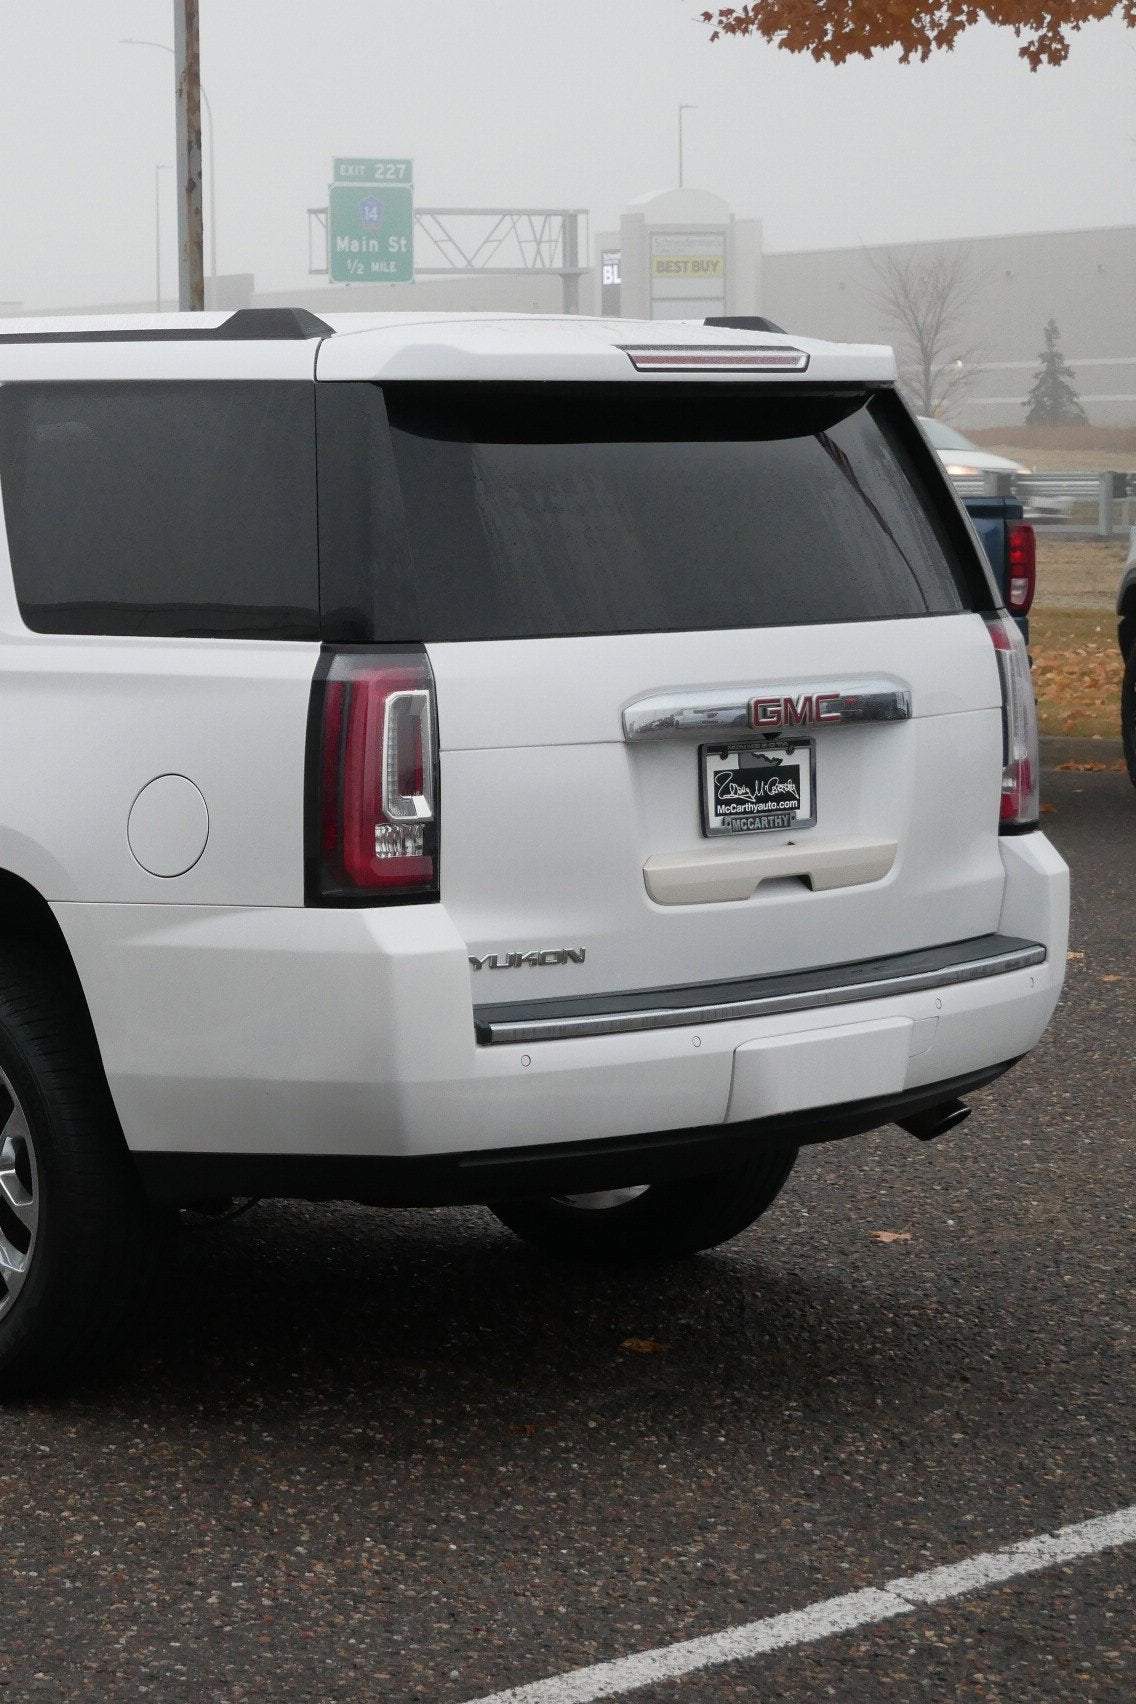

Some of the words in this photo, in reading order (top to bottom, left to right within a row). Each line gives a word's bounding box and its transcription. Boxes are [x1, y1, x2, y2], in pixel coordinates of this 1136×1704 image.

[339, 164, 365, 176] EXIT
[374, 163, 406, 179] 227
[364, 206, 378, 221] 14
[336, 236, 379, 252] Main
[388, 236, 408, 252] St
[370, 261, 397, 272] MILE
[656, 260, 688, 273] BEST
[691, 260, 720, 273] BUY
[751, 693, 841, 728] GMC
[727, 741, 790, 750] MINNESOTA
[717, 800, 798, 814] McCarthyauto.com
[732, 815, 790, 831] MCCARTHY
[467, 947, 586, 971] YUKON
